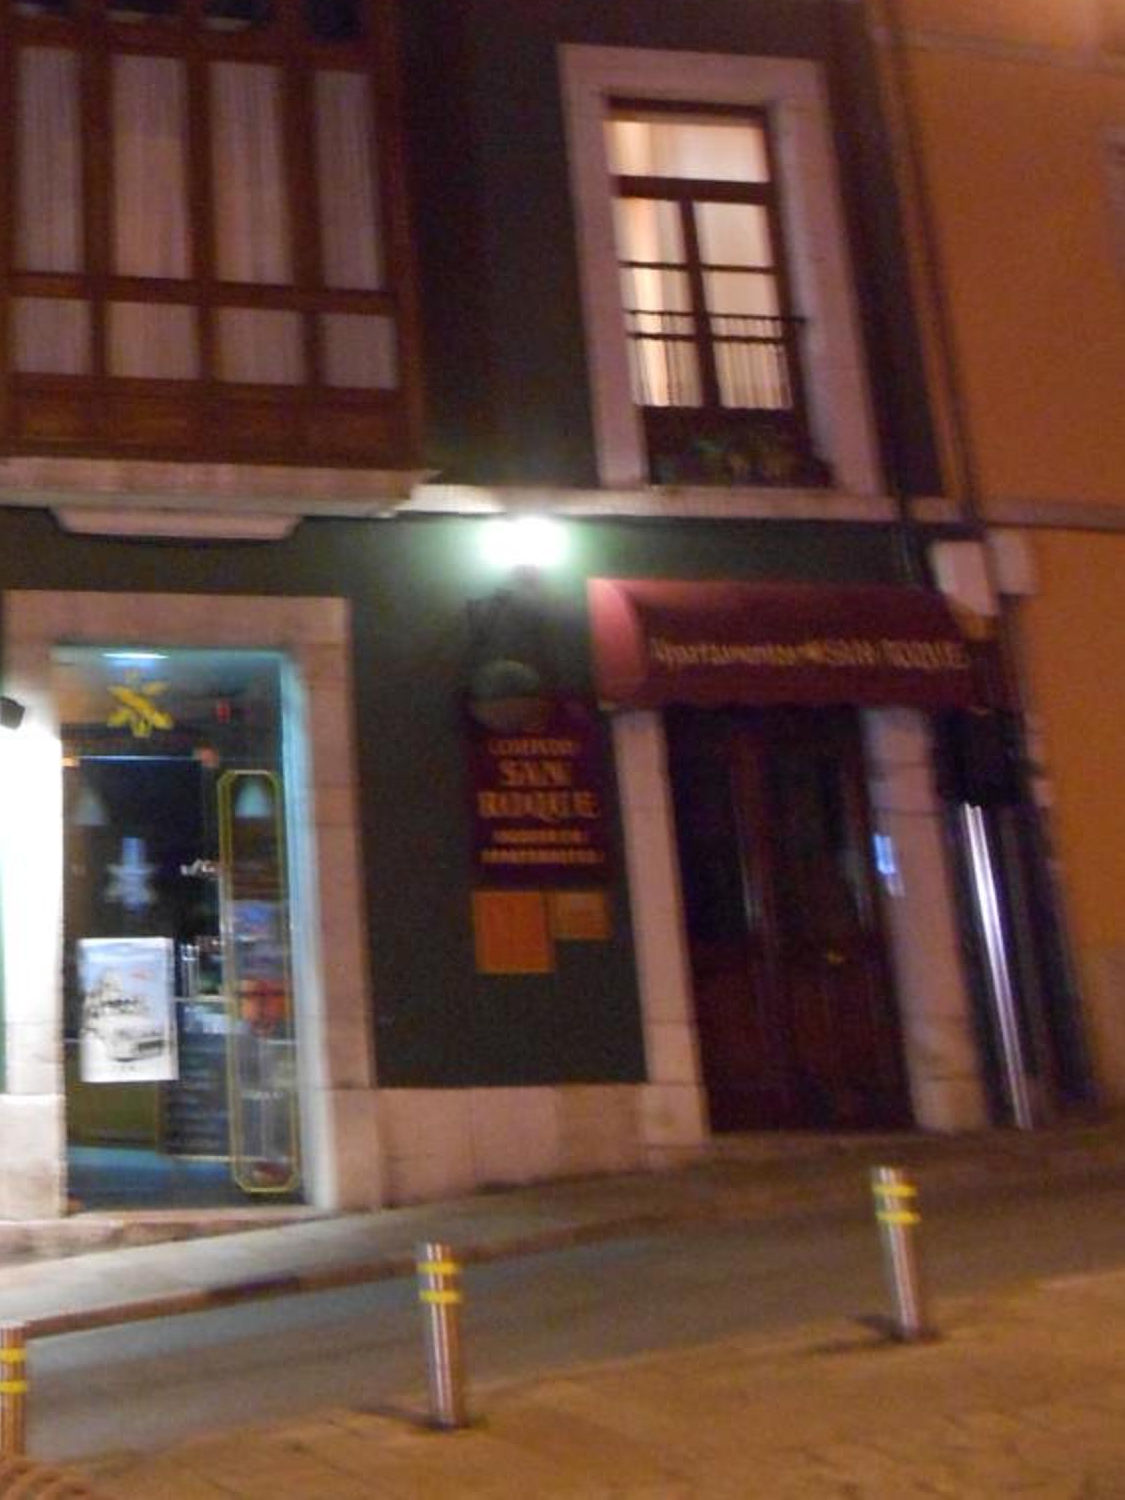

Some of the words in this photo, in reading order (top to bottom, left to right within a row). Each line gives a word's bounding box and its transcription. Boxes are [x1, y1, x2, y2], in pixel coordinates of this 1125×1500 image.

[824, 638, 875, 666] SAN
[881, 638, 970, 670] ROQUE
[498, 759, 571, 786] SAN
[477, 790, 602, 823] ROQUE
